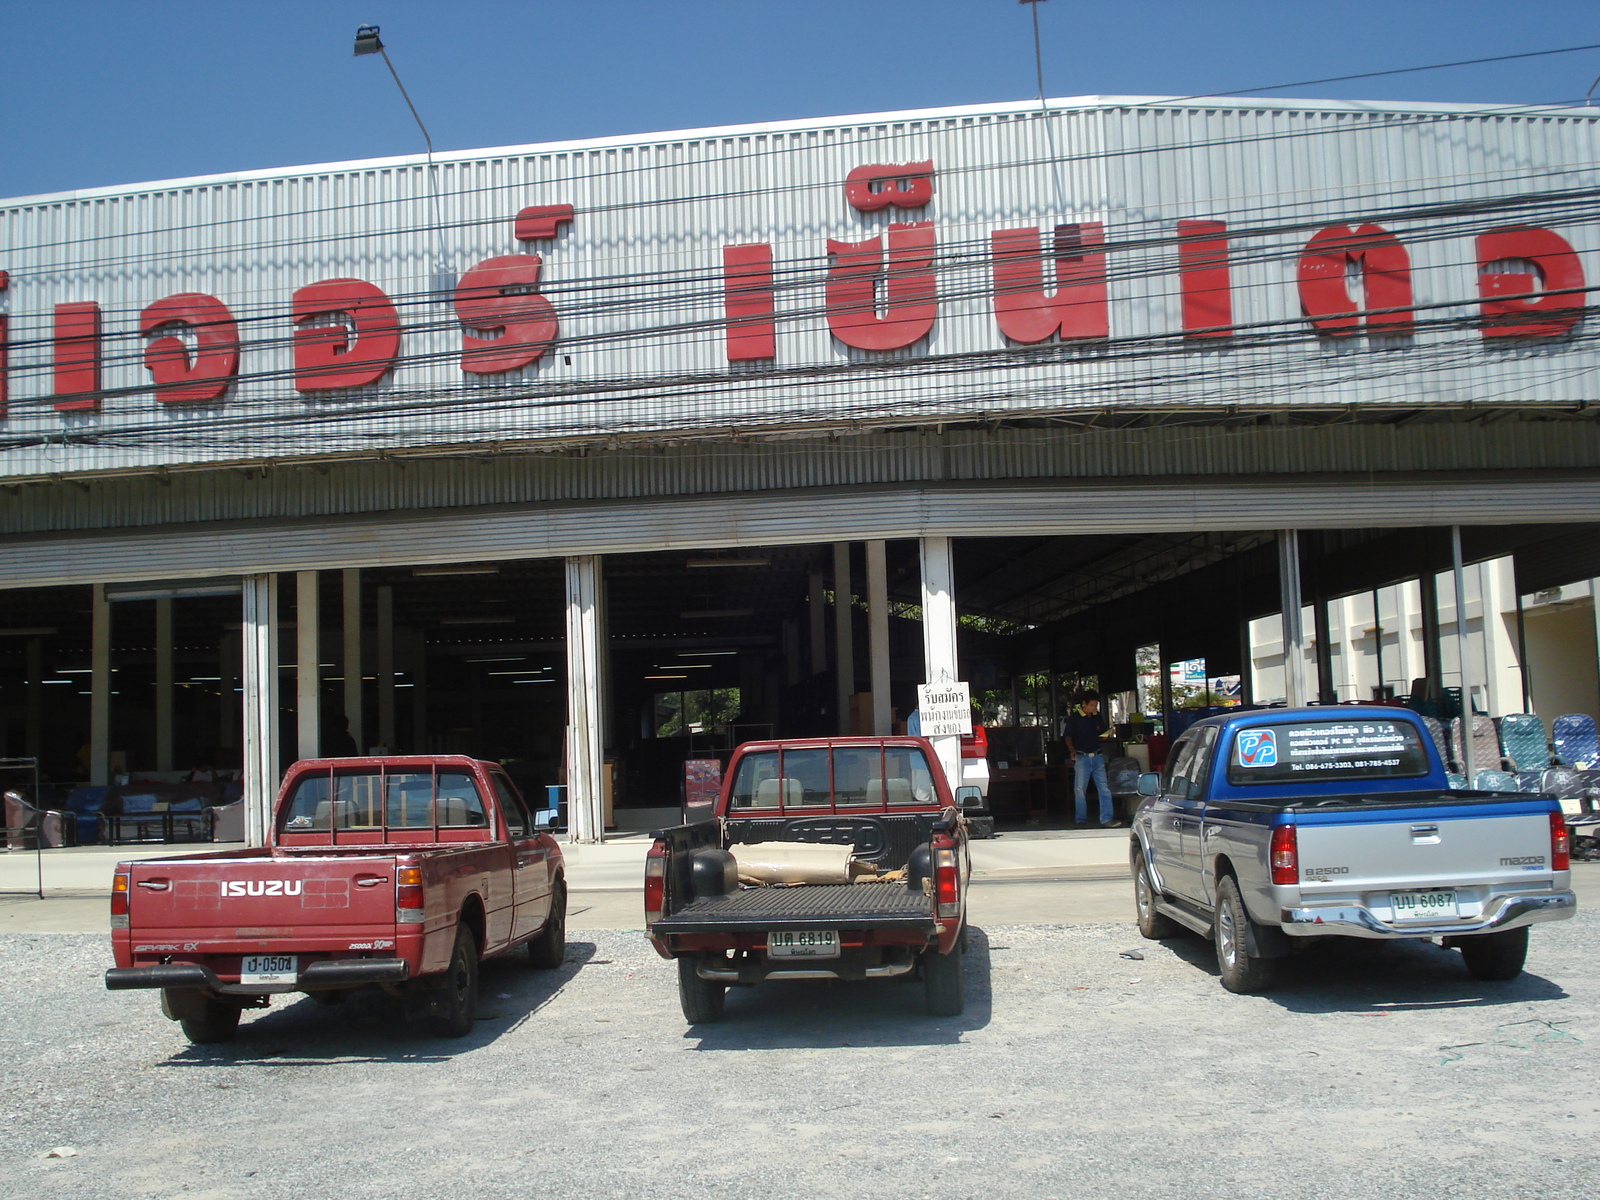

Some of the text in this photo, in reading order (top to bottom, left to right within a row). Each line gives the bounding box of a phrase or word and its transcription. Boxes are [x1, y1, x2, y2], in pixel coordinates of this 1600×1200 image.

[0, 203, 574, 418] เจอร์
[924, 687, 964, 705] รับสมัคร
[1377, 725, 1395, 734] 1,2
[1331, 737, 1341, 745] PC
[1291, 763, 1304, 771] Tel.
[1499, 855, 1546, 866] mazda
[221, 879, 302, 897] ISUZU
[1420, 893, 1453, 908] 6087
[798, 931, 833, 946] 6819
[133, 941, 200, 953] SPARK EX
